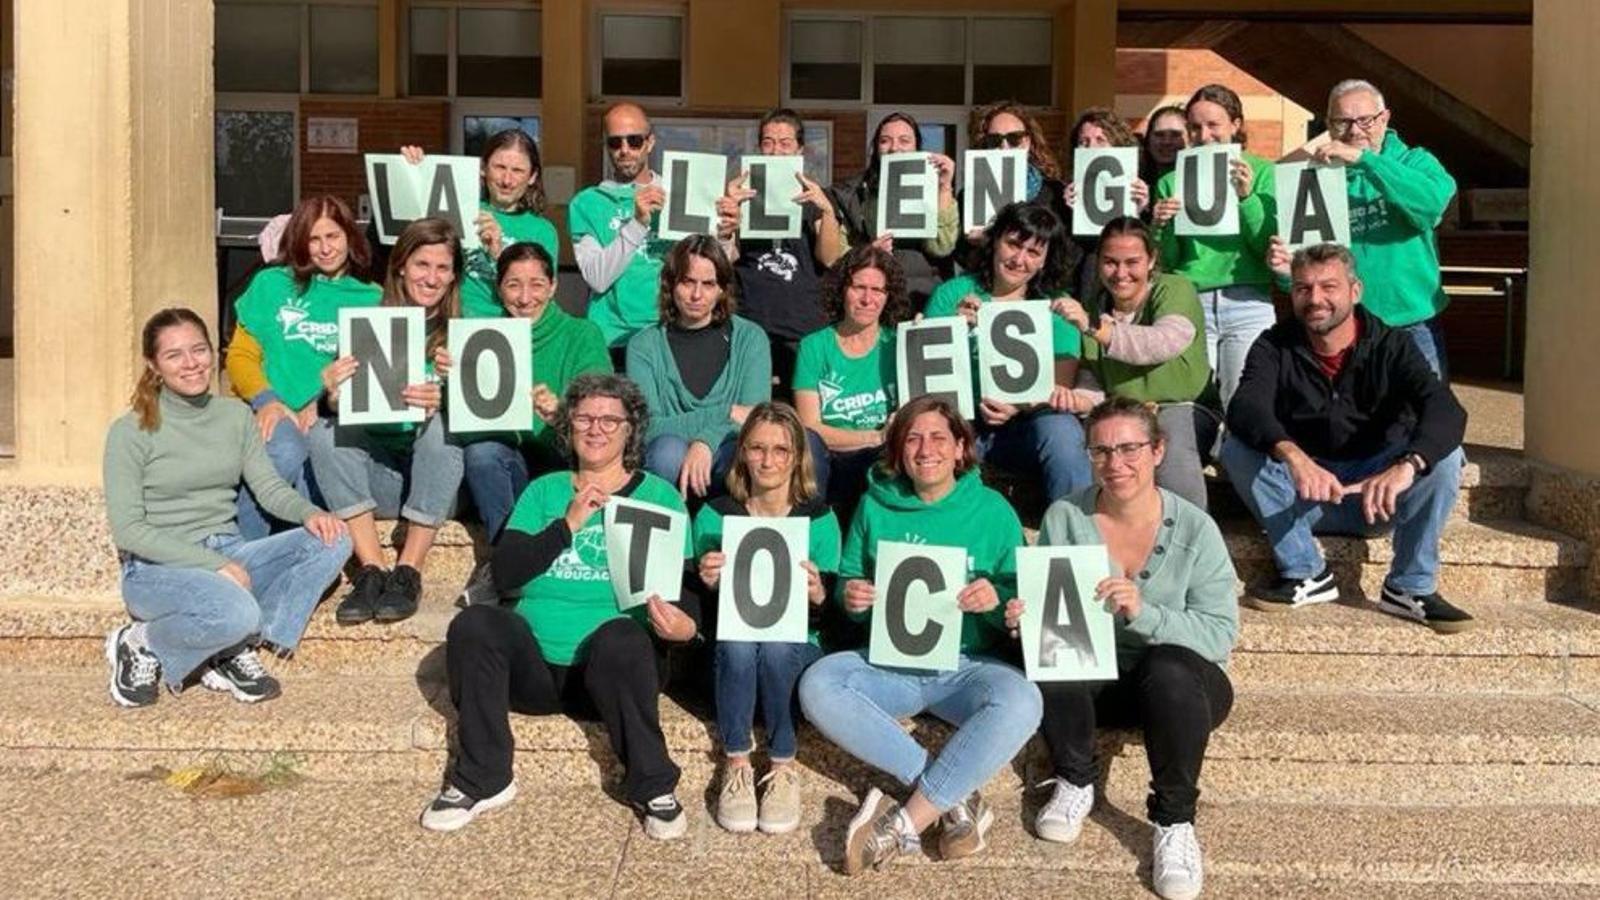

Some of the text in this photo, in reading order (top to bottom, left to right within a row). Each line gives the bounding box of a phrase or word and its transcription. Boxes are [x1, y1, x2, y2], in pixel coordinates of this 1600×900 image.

[373, 163, 466, 239] LA
[667, 160, 711, 233] L
[747, 164, 790, 231] L
[886, 159, 926, 229] E
[973, 156, 1016, 226] N
[1082, 155, 1126, 227] G
[1183, 152, 1228, 227] U
[1289, 168, 1337, 244] A
[297, 321, 338, 336] CRID
[351, 317, 409, 413] N
[990, 310, 1040, 394] S
[460, 328, 516, 420] O
[906, 326, 959, 412] E
[614, 505, 671, 595] T
[733, 527, 792, 629] O
[885, 556, 946, 657] C
[1038, 558, 1098, 668] A
